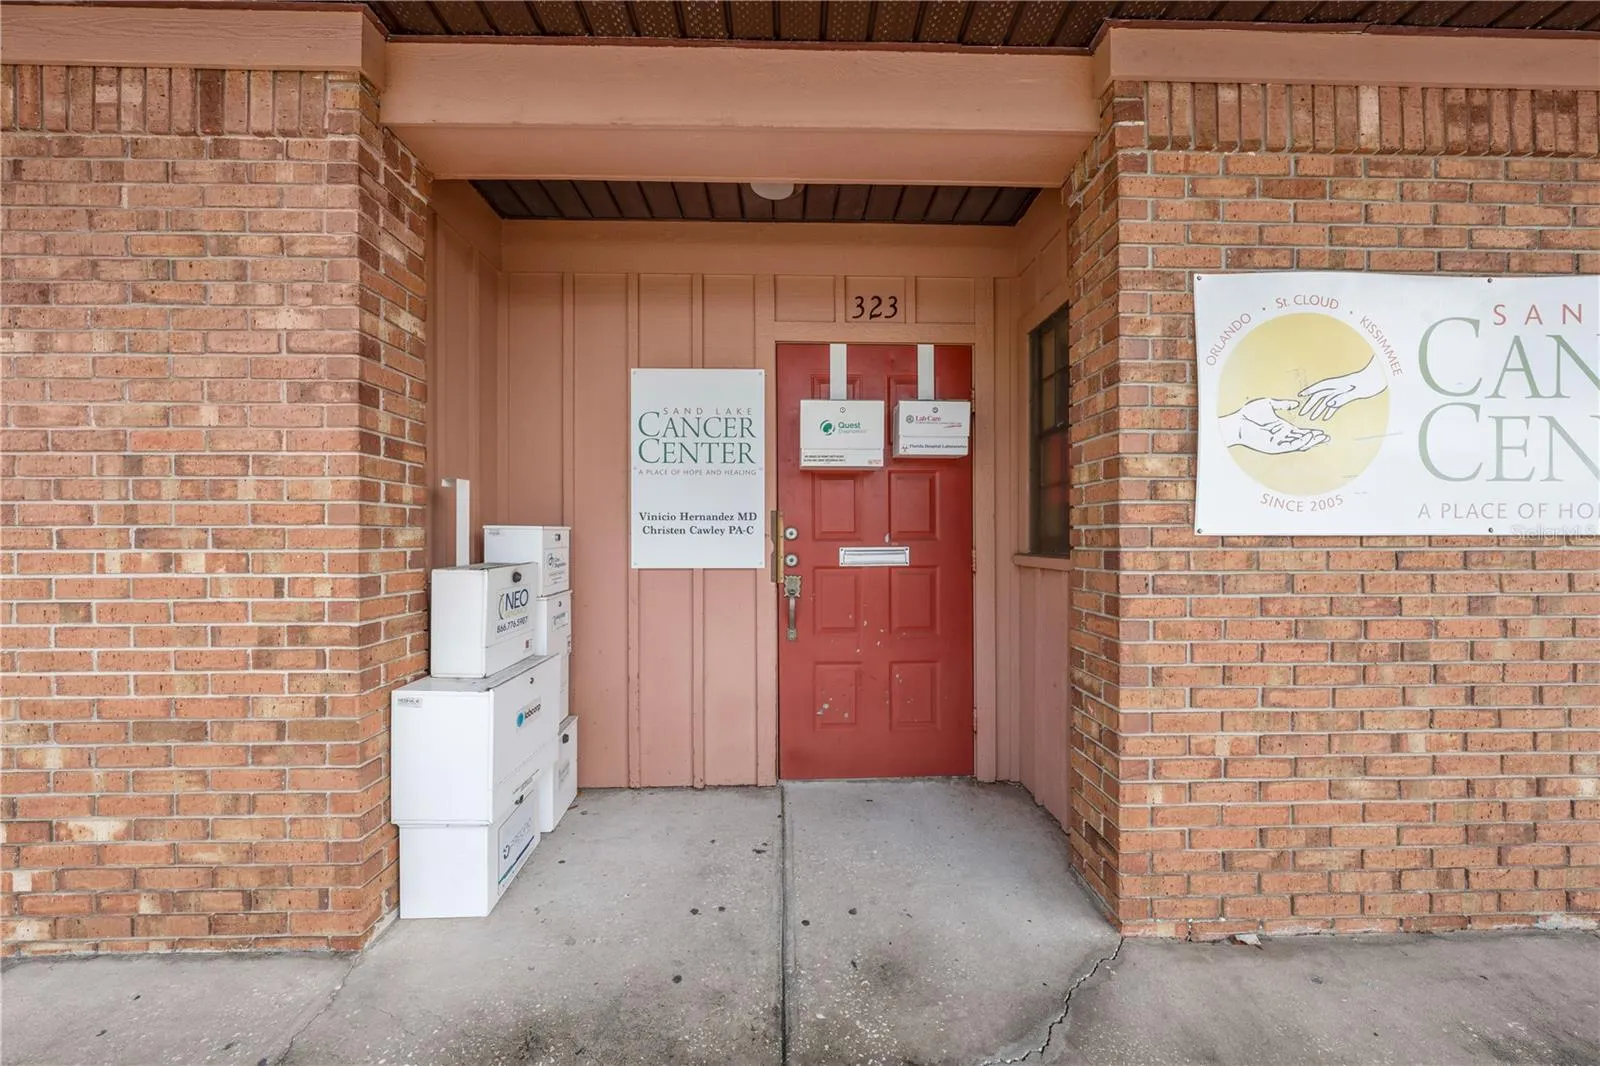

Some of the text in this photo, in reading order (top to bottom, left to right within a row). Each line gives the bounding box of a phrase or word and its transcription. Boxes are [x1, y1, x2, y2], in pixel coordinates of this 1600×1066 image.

[852, 295, 898, 320] 323
[1493, 303, 1582, 326] SAN
[1206, 313, 1252, 366] ORLANDO
[1293, 294, 1339, 310] CLOUD
[1360, 315, 1403, 376] KISSIMMEE
[663, 407, 752, 415] SAND LAKE
[638, 411, 757, 438] CANCER
[838, 421, 861, 429] Quest
[638, 438, 756, 464] CENTER
[1260, 493, 1344, 512] SINCE 2005
[1418, 503, 1600, 519] A PLACE OF HO
[639, 512, 757, 521] Vinicio Hernandez MD
[642, 525, 754, 536] Christen Cawley PA-C
[505, 588, 529, 611] NEO
